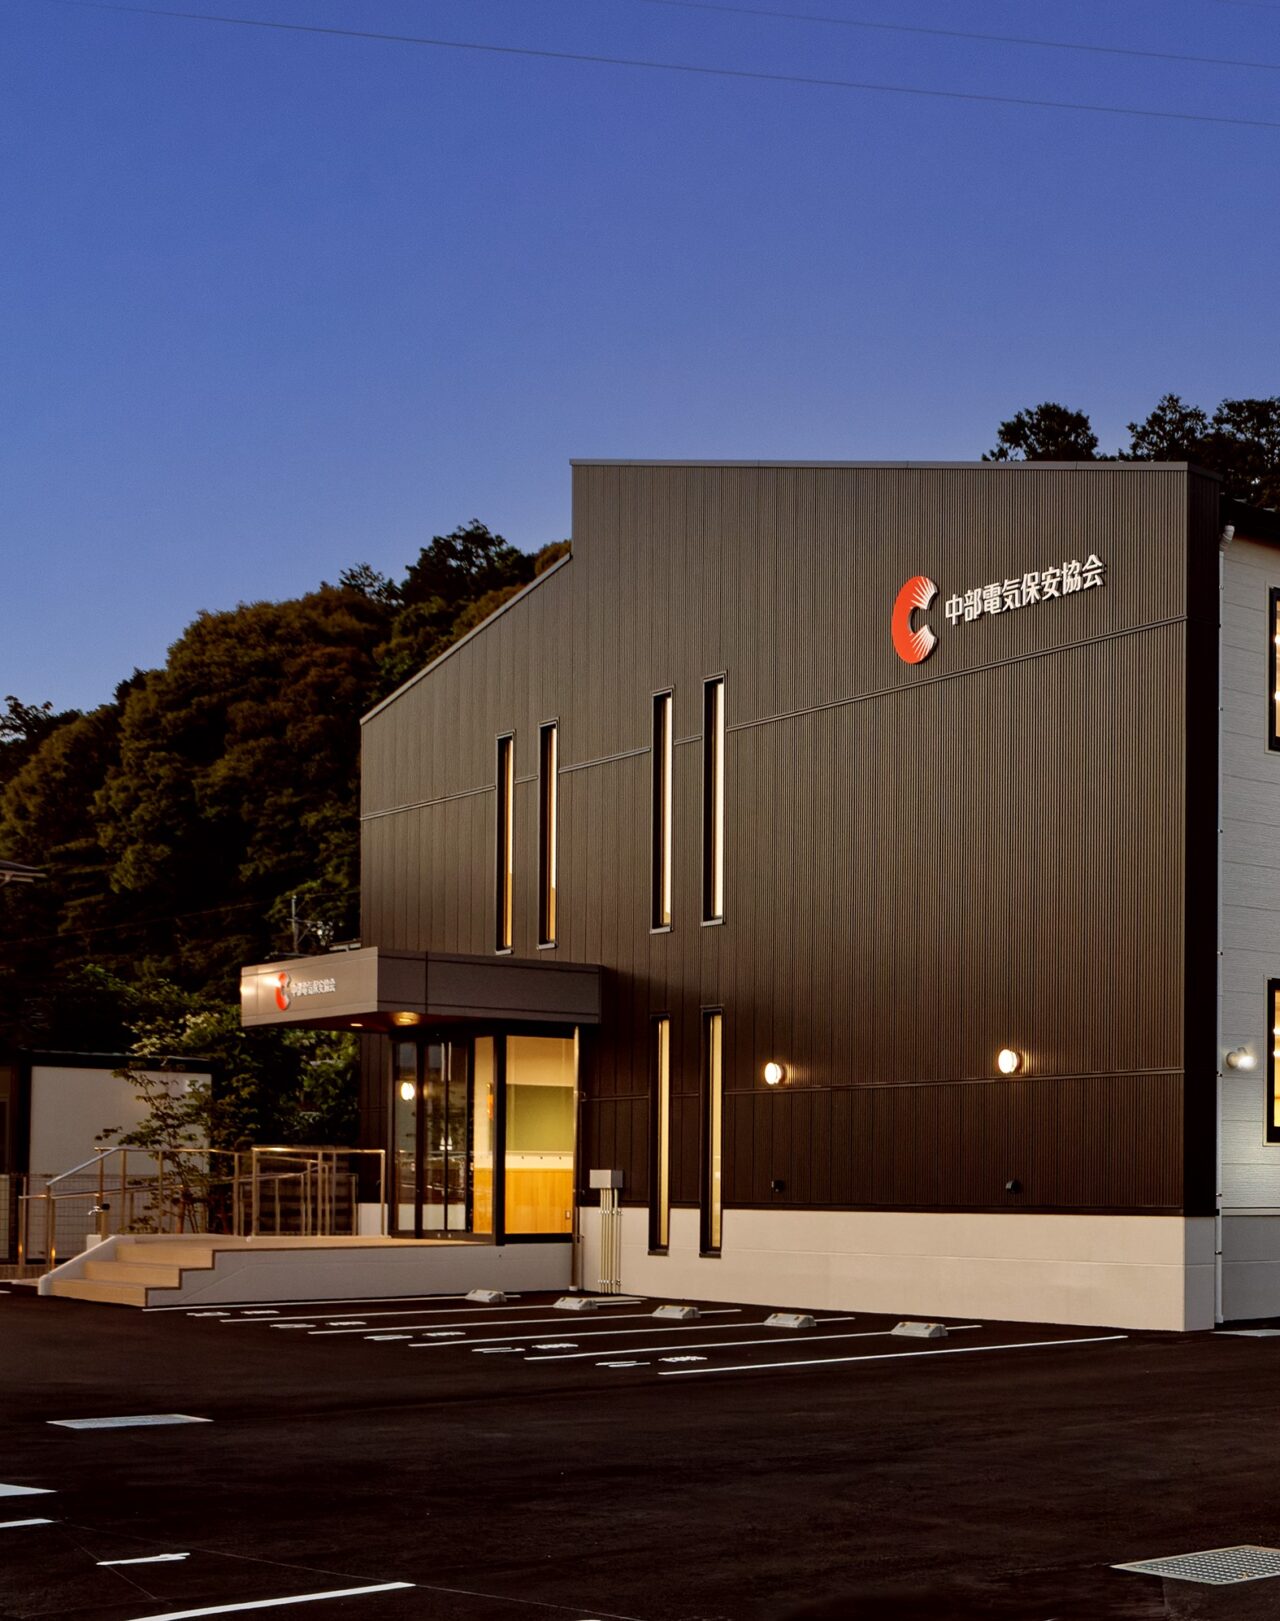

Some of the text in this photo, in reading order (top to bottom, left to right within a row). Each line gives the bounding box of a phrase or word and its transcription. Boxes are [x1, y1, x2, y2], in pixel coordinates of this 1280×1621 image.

[945, 554, 1104, 625] 中部電気保安協会
